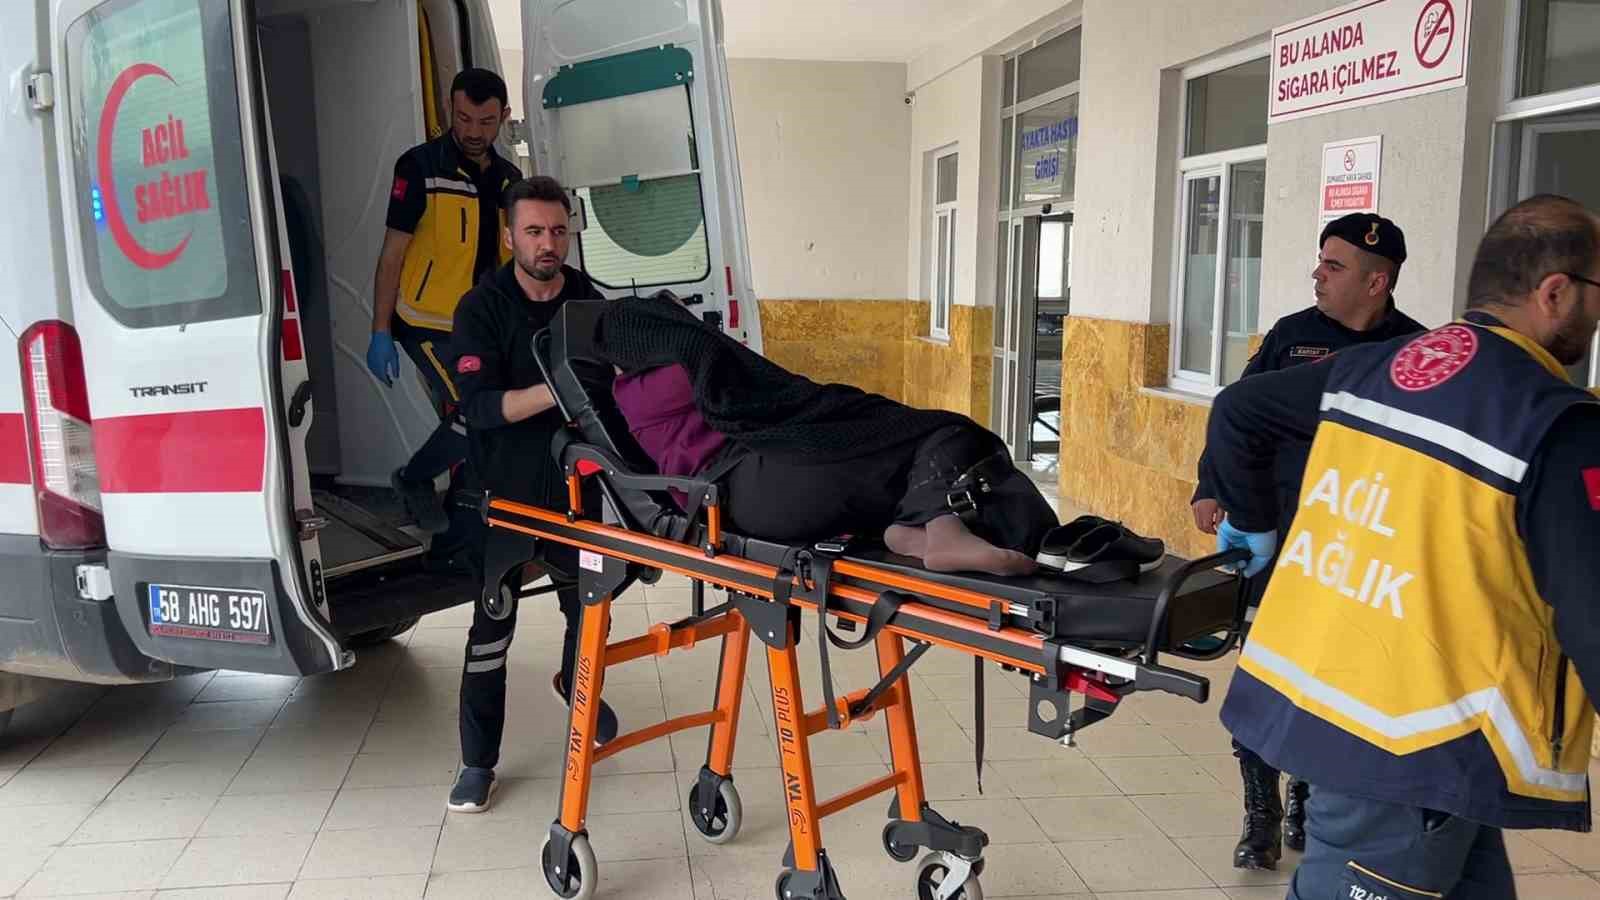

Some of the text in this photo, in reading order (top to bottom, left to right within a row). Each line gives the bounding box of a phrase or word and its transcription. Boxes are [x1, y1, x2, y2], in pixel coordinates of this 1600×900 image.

[1280, 22, 1364, 68] BU ALANDA
[143, 112, 189, 168] ACİL
[135, 168, 213, 224] SAĞLIK
[129, 381, 208, 398] TRANSIT
[1304, 468, 1396, 537] ACİL
[1279, 530, 1415, 619] AĞLIK
[160, 589, 262, 630] 58 AHG 597
[570, 727, 583, 753] TAY
[578, 655, 592, 690] PLUS
[775, 686, 791, 724] PLUS
[780, 727, 794, 744] 10
[787, 772, 802, 802] TAY
